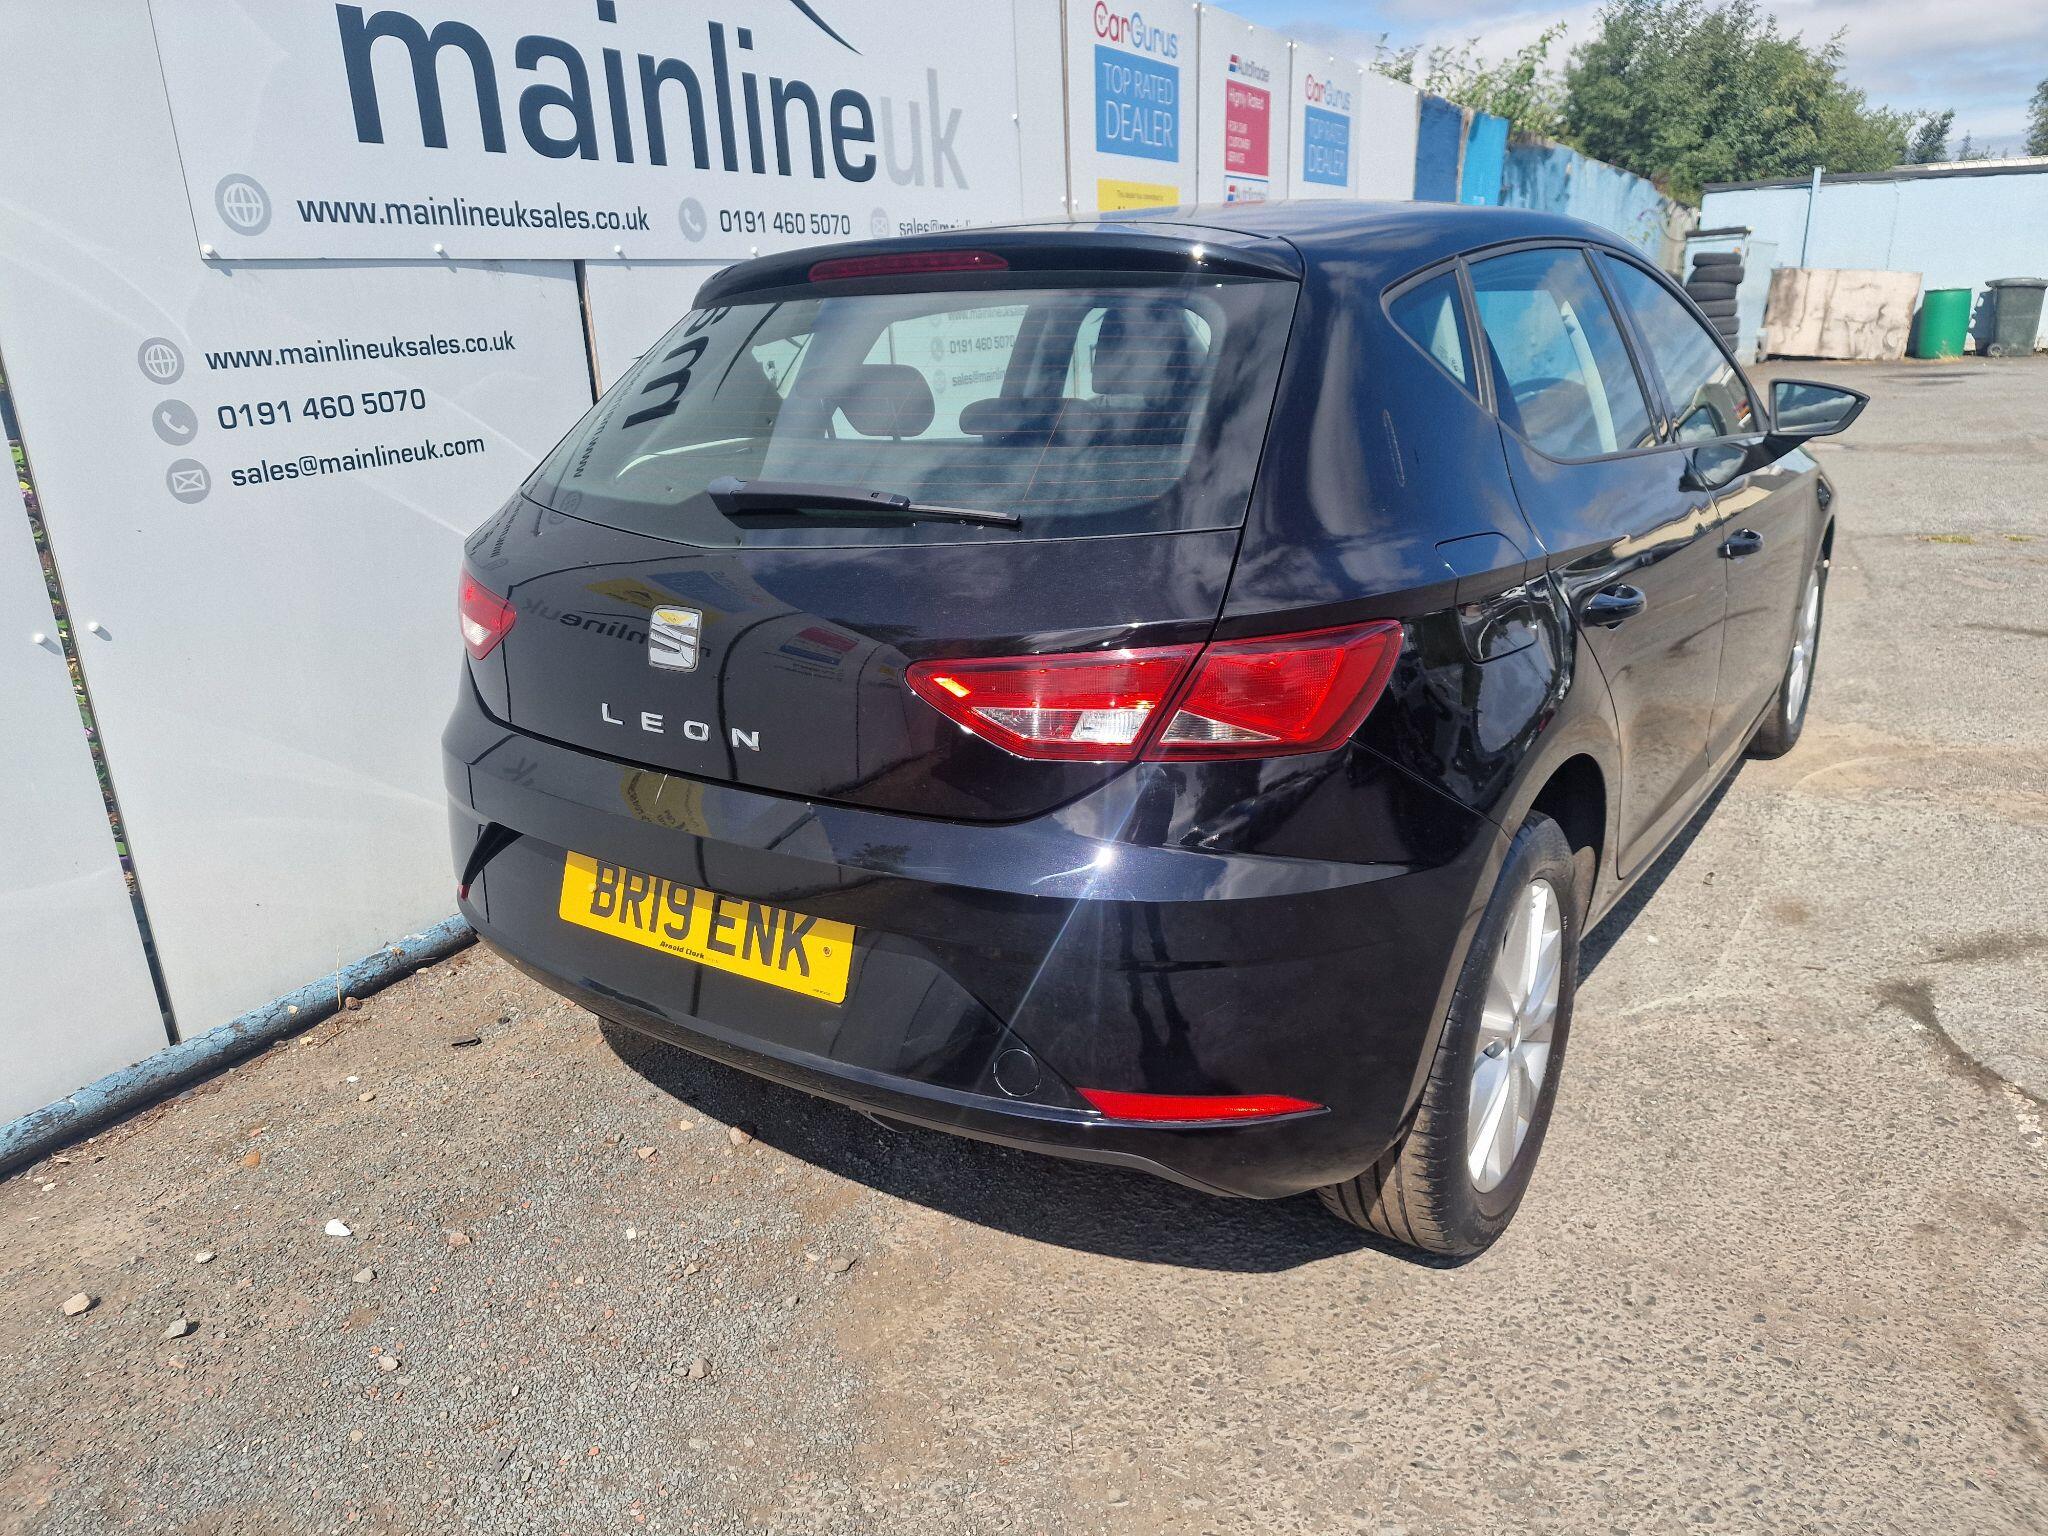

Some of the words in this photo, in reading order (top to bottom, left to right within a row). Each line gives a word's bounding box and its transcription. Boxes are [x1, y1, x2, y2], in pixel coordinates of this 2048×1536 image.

[1093, 0, 1179, 59] CarGurus
[1102, 61, 1133, 96] TOP
[1132, 69, 1176, 107] RATED
[1104, 99, 1175, 149] DEALER
[297, 196, 651, 232] www.mainlineuksales.co.uk
[719, 208, 767, 235] 0191
[773, 210, 806, 236] 460
[810, 212, 851, 237] 5070
[204, 330, 517, 371] www.mainlineuksales.co.uk
[950, 338, 973, 354] 0191
[216, 400, 294, 431] 0191
[301, 393, 356, 422] 460
[360, 387, 427, 417] 5070
[230, 434, 486, 488] sales@mainlineuk.com
[601, 701, 761, 752] LEON
[589, 858, 696, 941] BR19
[706, 893, 818, 978] ENK
[660, 940, 685, 953] Arnold
[685, 947, 705, 960] Clark
